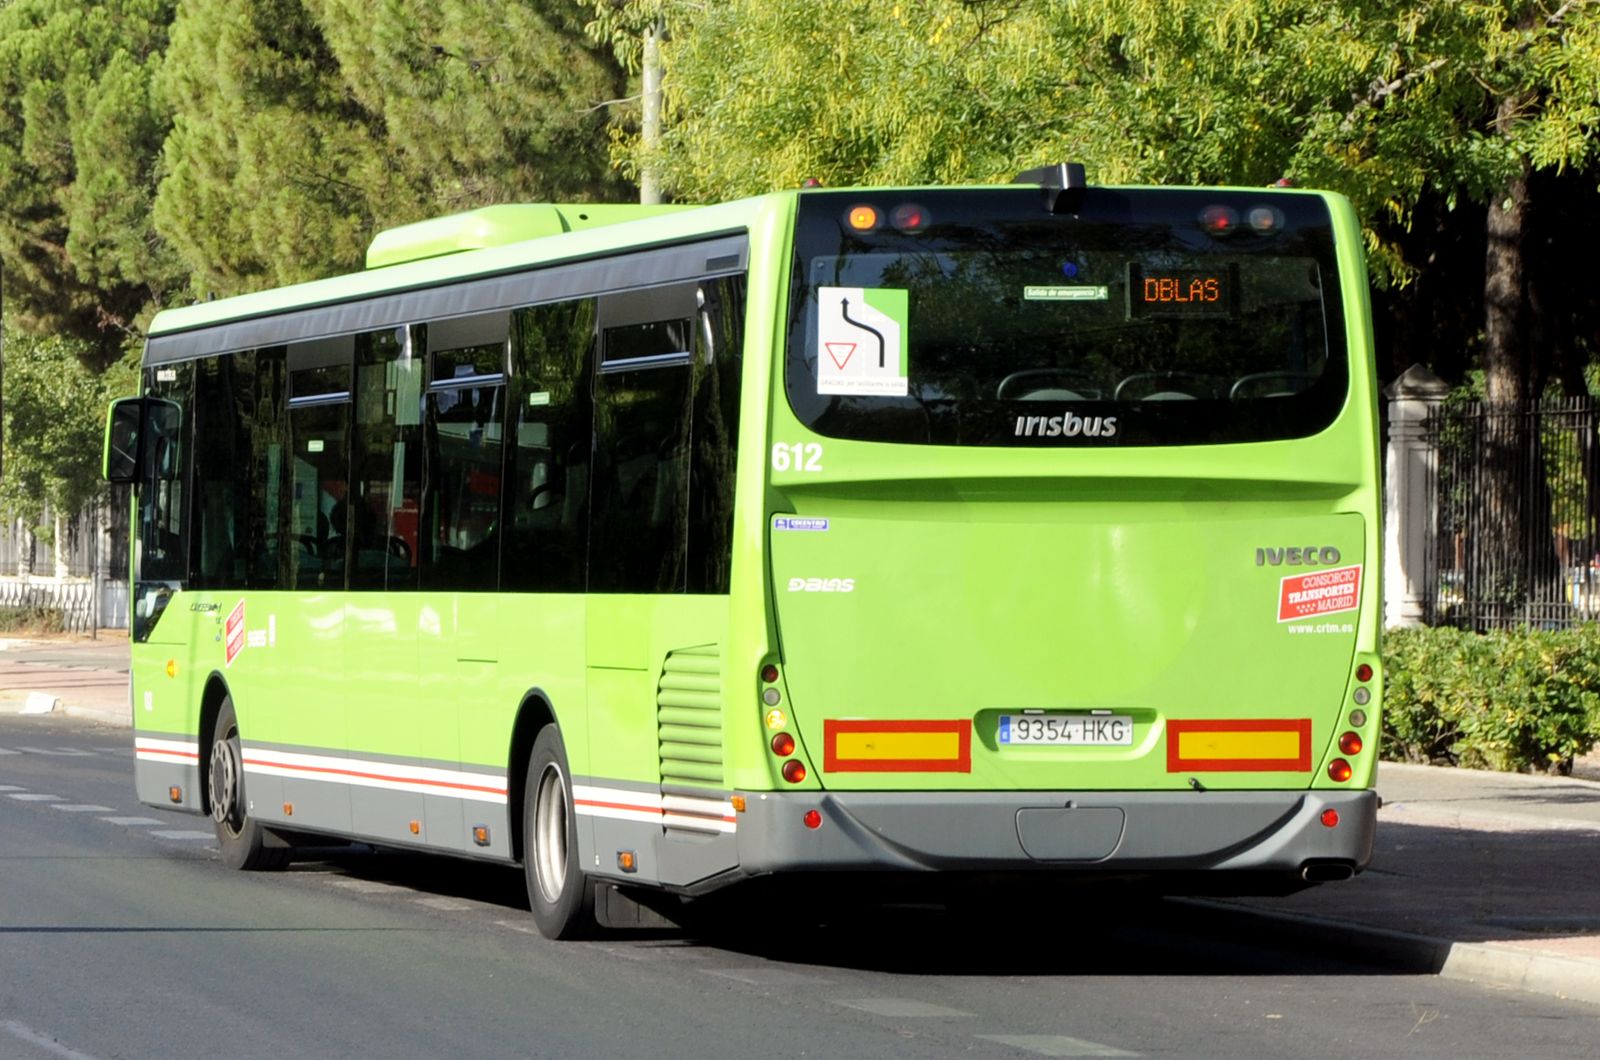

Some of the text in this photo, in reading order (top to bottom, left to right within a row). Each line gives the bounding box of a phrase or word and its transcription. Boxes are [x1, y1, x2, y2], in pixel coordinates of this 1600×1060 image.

[1144, 278, 1219, 302] DBLAS
[1014, 412, 1117, 437] irisbus
[771, 442, 823, 472] 612
[1256, 546, 1341, 567] IVECO
[1302, 570, 1356, 589] CONSORCIO
[1288, 582, 1355, 604] TRANSPORTES
[1317, 595, 1354, 611] MADRID
[1288, 623, 1353, 634] www.crtm.es
[1017, 719, 1124, 742] 9354 HKG
